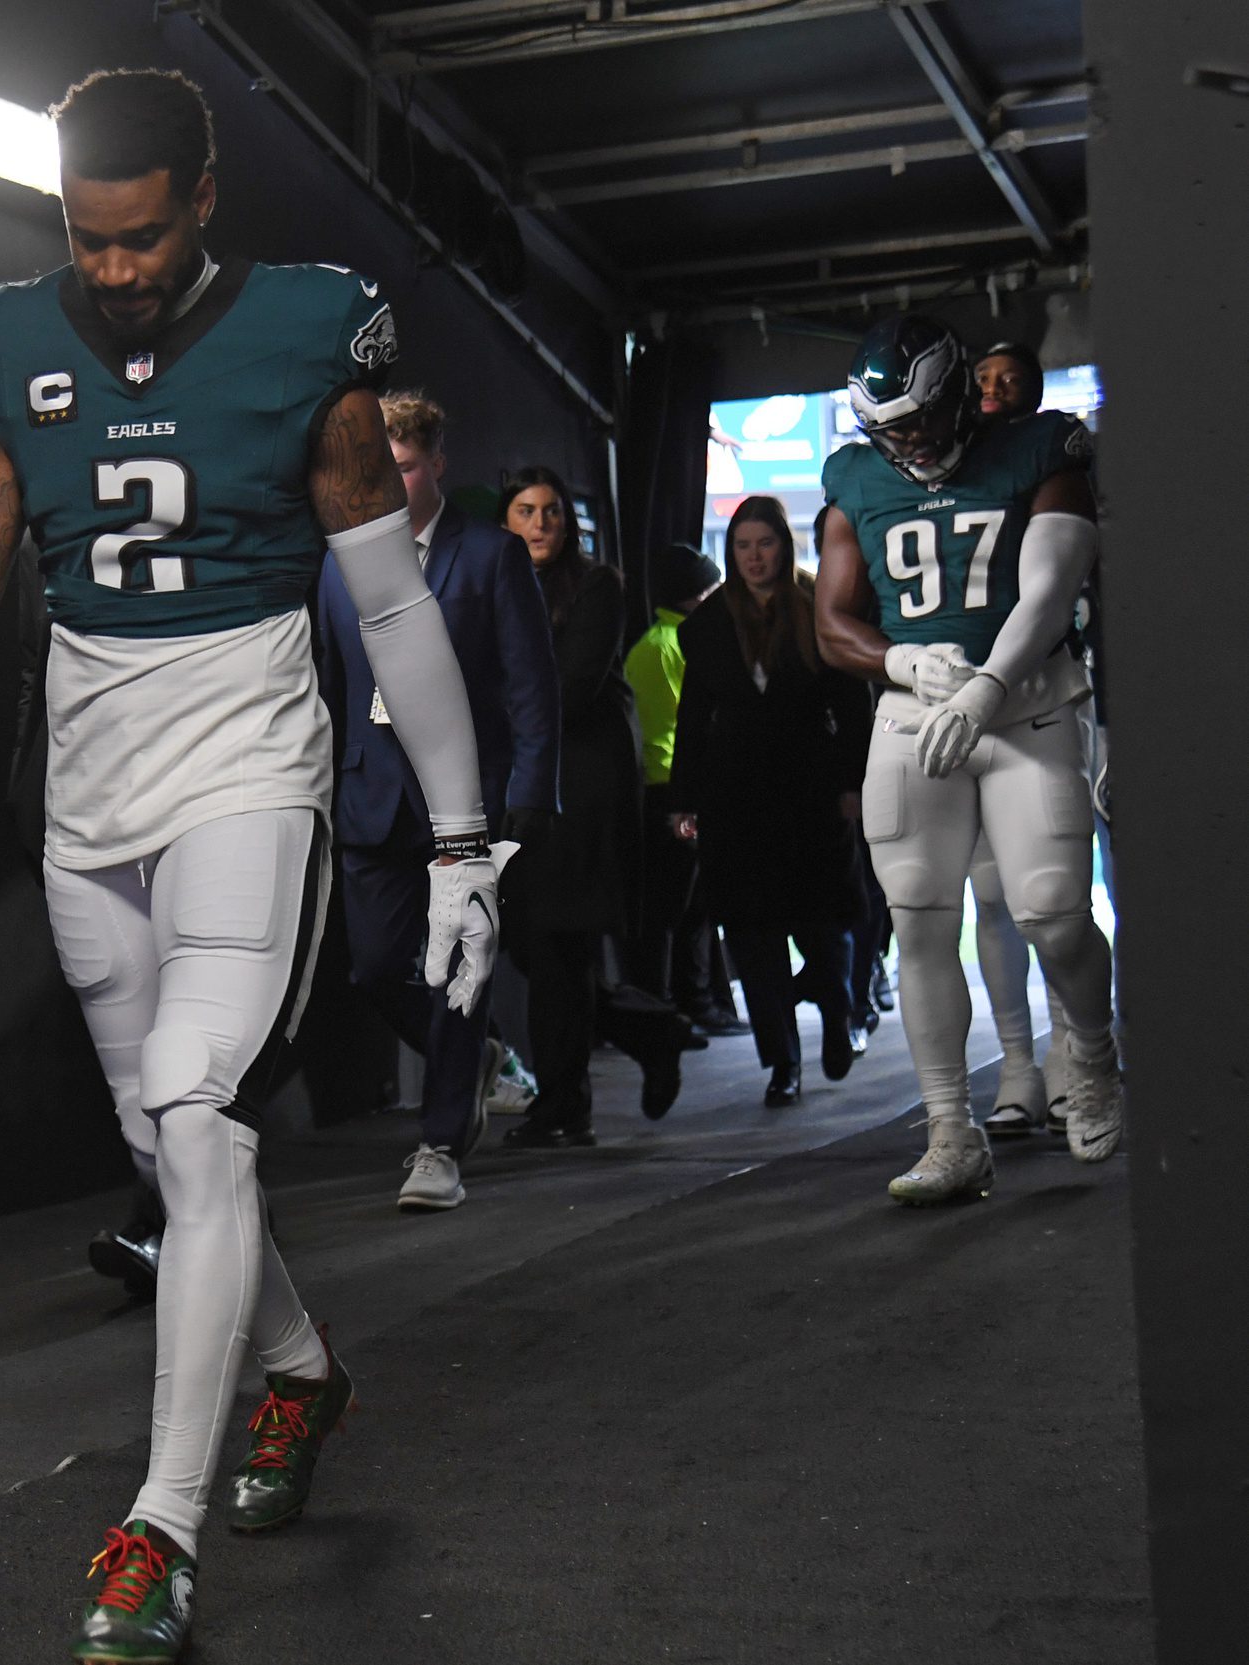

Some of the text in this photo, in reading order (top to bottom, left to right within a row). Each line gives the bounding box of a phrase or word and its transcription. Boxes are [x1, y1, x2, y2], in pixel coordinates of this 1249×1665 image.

[130, 364, 148, 377] NFL
[29, 373, 73, 413] C
[106, 421, 177, 440] EAGLES
[918, 499, 956, 512] EAGLES
[90, 459, 188, 593] 2
[885, 510, 1006, 618] 97
